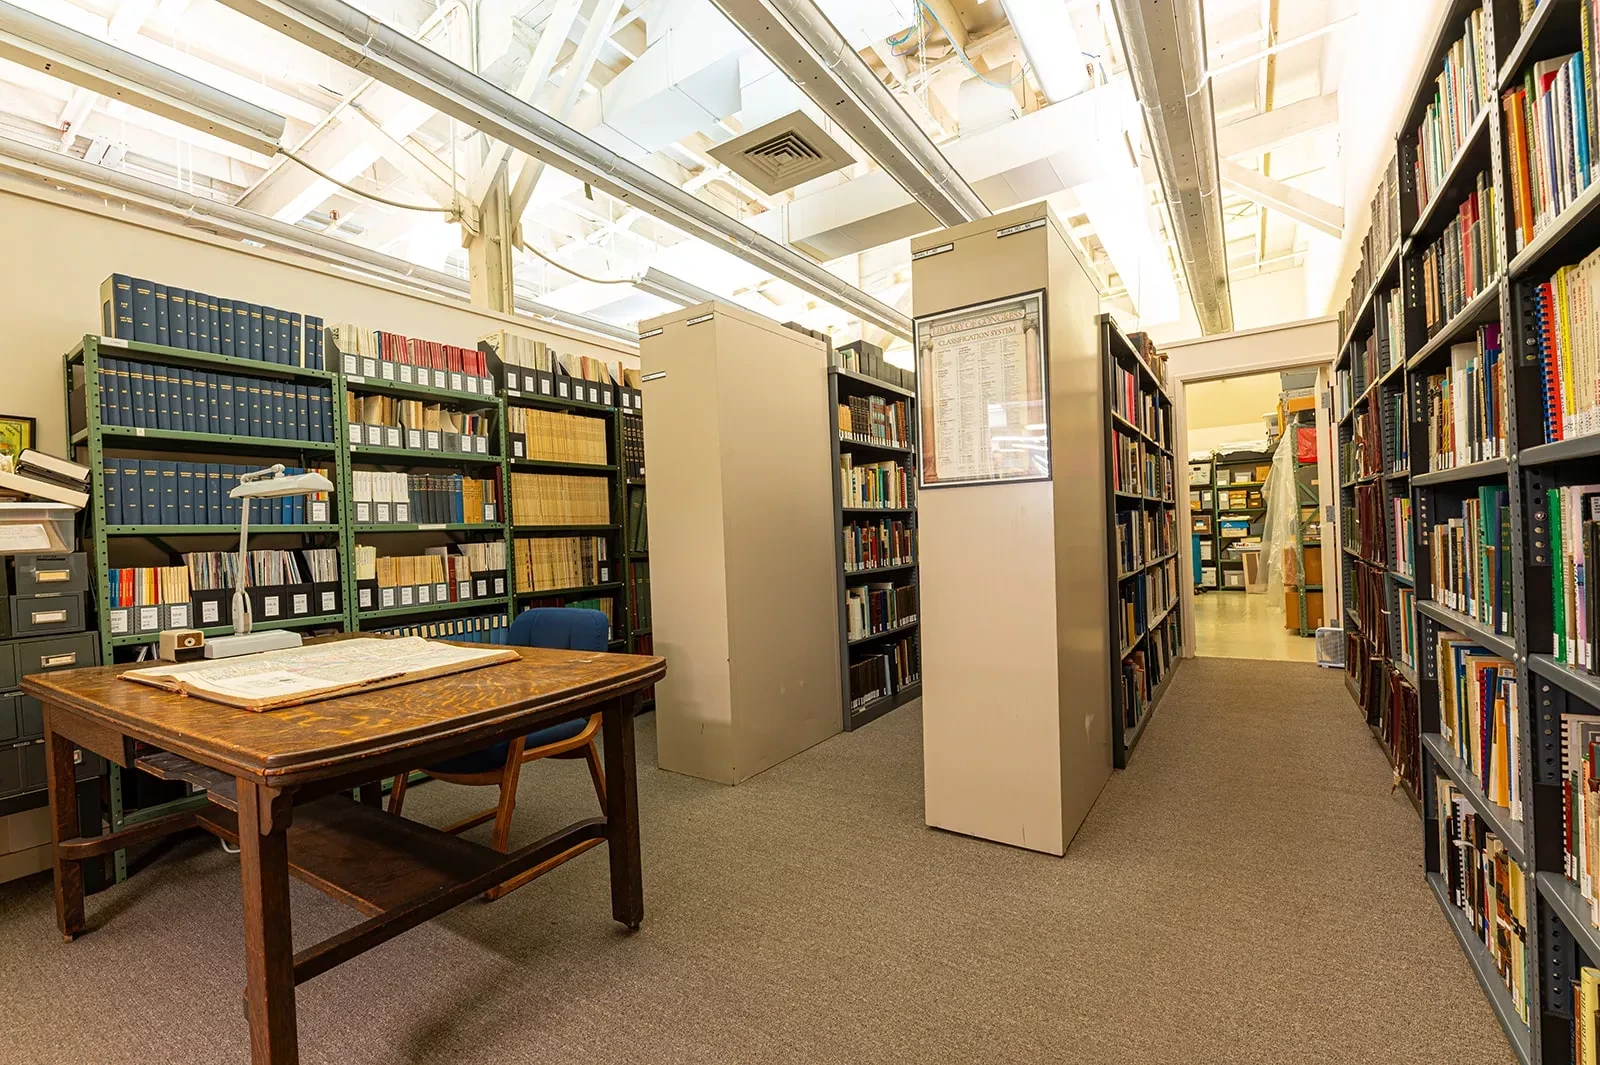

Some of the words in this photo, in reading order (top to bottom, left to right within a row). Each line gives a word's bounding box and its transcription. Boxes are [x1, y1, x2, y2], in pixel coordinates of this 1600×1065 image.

[932, 323, 964, 334] LIBRARY
[964, 318, 976, 328] OF
[978, 311, 1023, 326] CONGRESS
[938, 331, 988, 346] CLASSIFICATION
[988, 325, 1016, 337] SYSTEM
